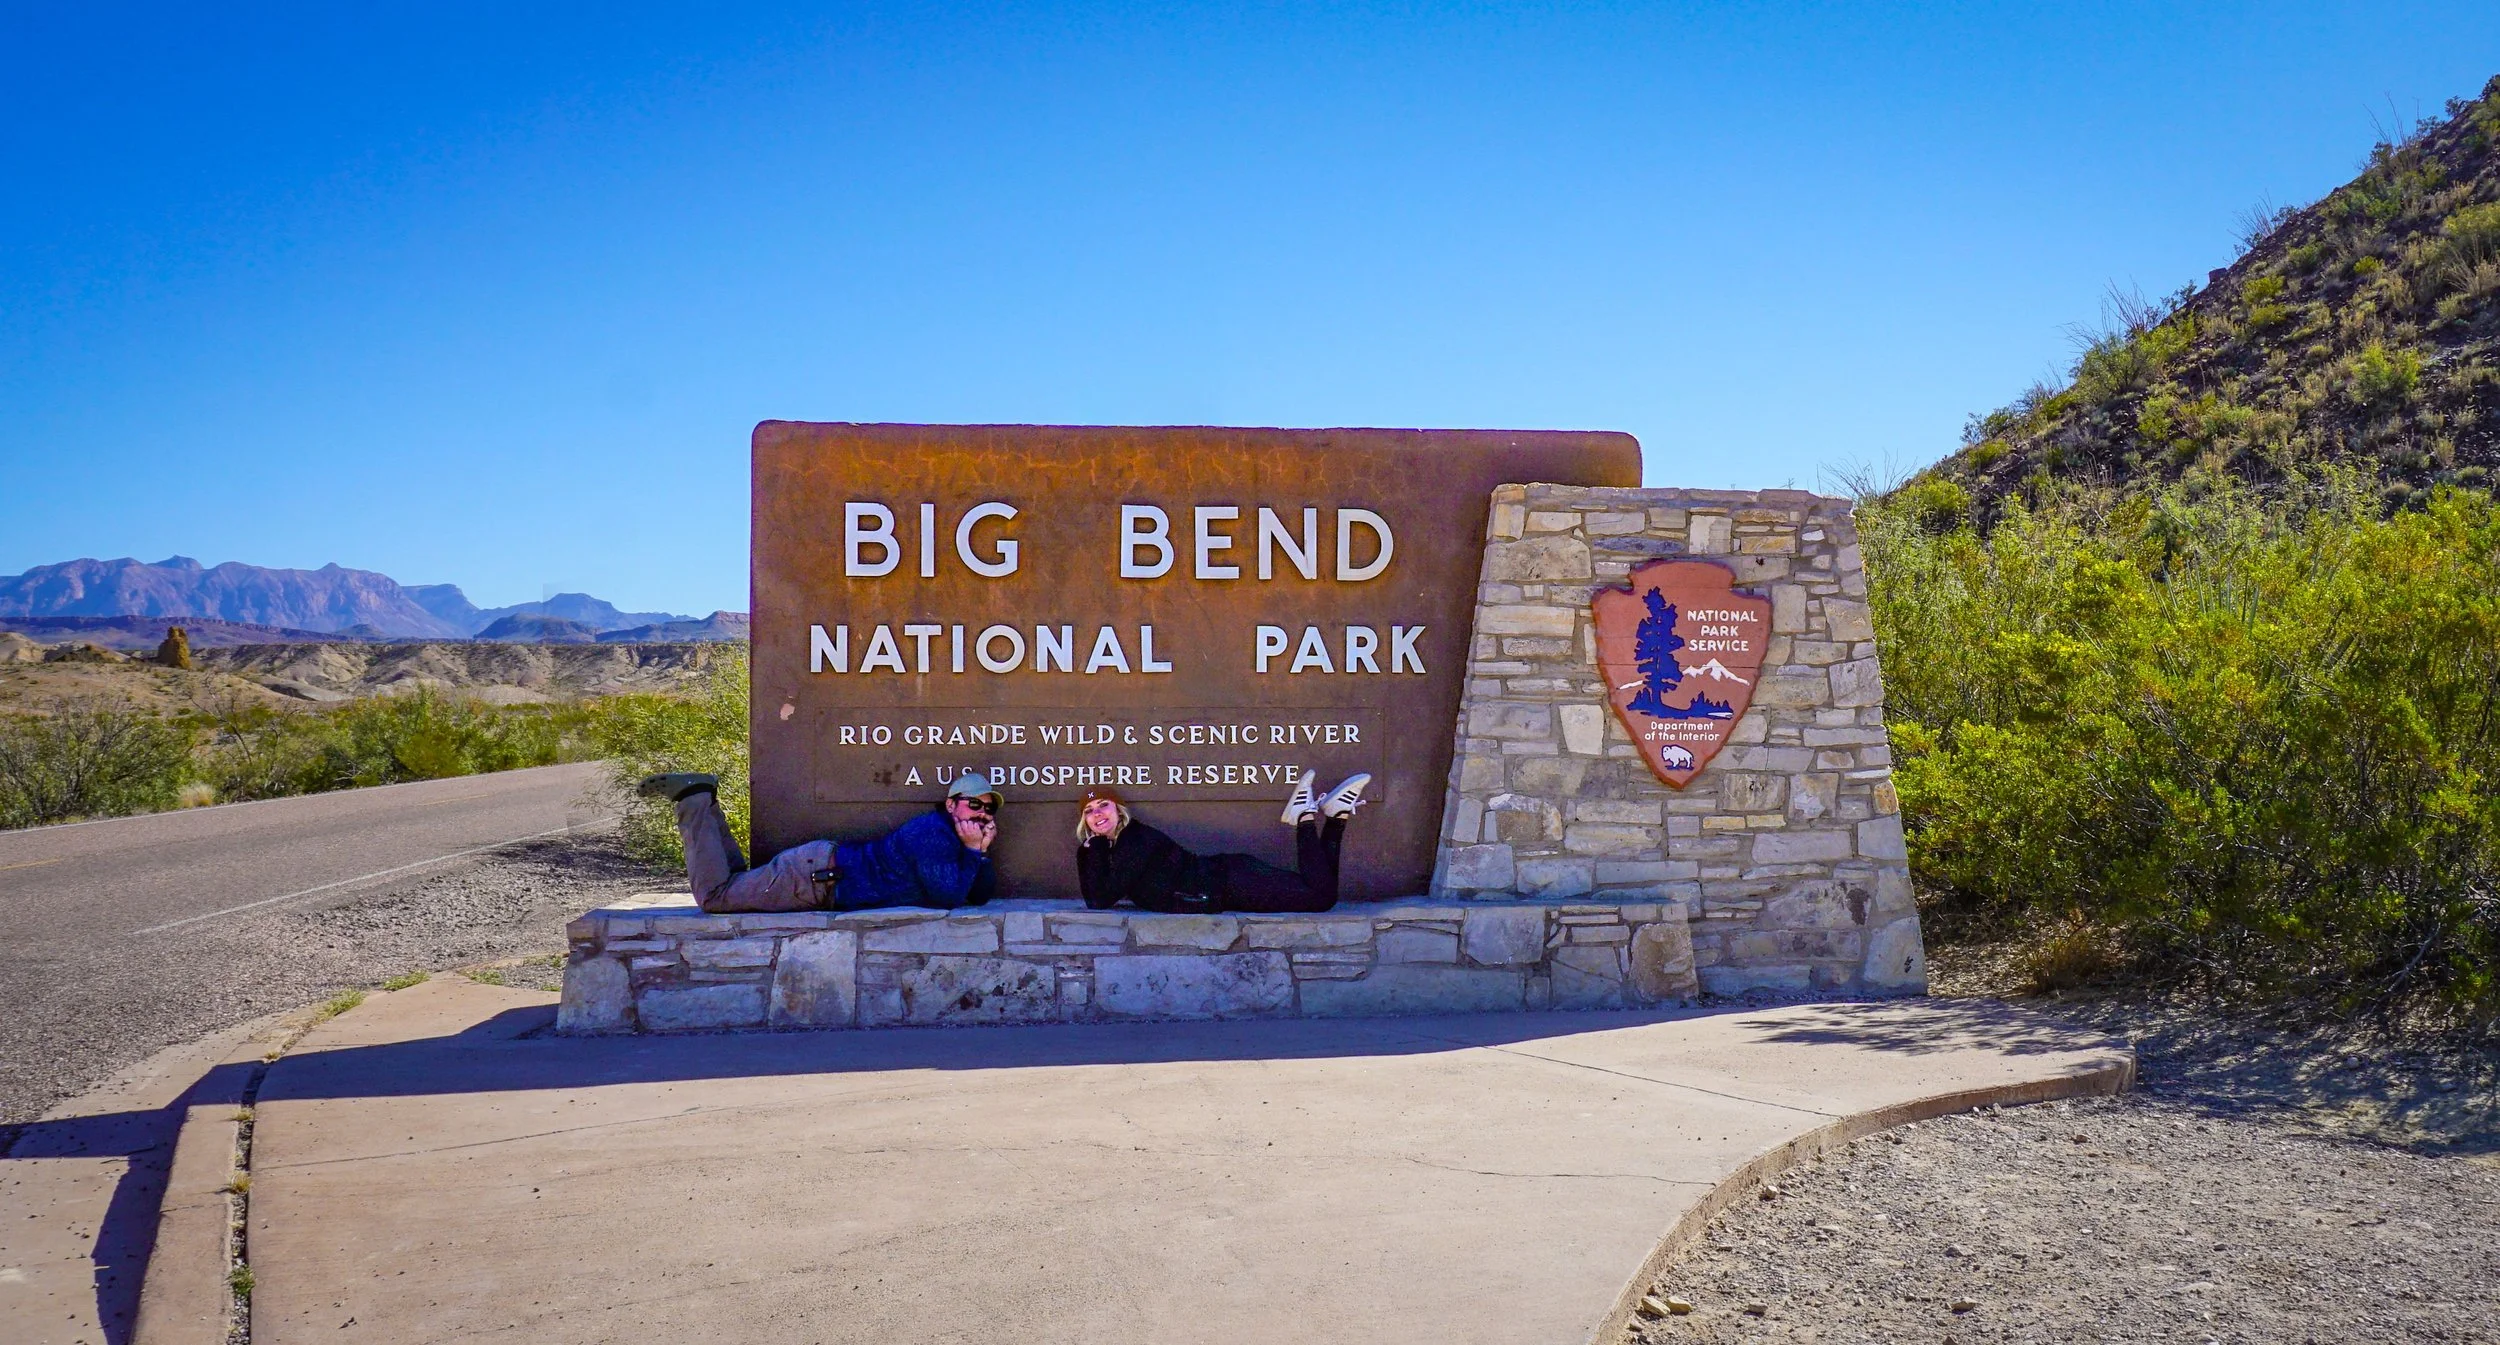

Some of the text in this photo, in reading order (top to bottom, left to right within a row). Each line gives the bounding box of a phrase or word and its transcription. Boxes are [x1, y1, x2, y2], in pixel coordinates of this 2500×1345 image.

[844, 501, 1395, 582] BIG BEND
[1687, 609, 1758, 623] NATIONAL
[1700, 625, 1739, 637] PARK
[809, 624, 1427, 674] NATIONAL PARK
[1688, 638, 1750, 652] SERVICE
[1650, 721, 1714, 732] Department
[838, 724, 1361, 745] RIO GRANDE WILD & SCENIC RIVER
[1644, 731, 1721, 741] of the Interior
[904, 766, 924, 786] A
[1167, 764, 1300, 785] RESERVE
